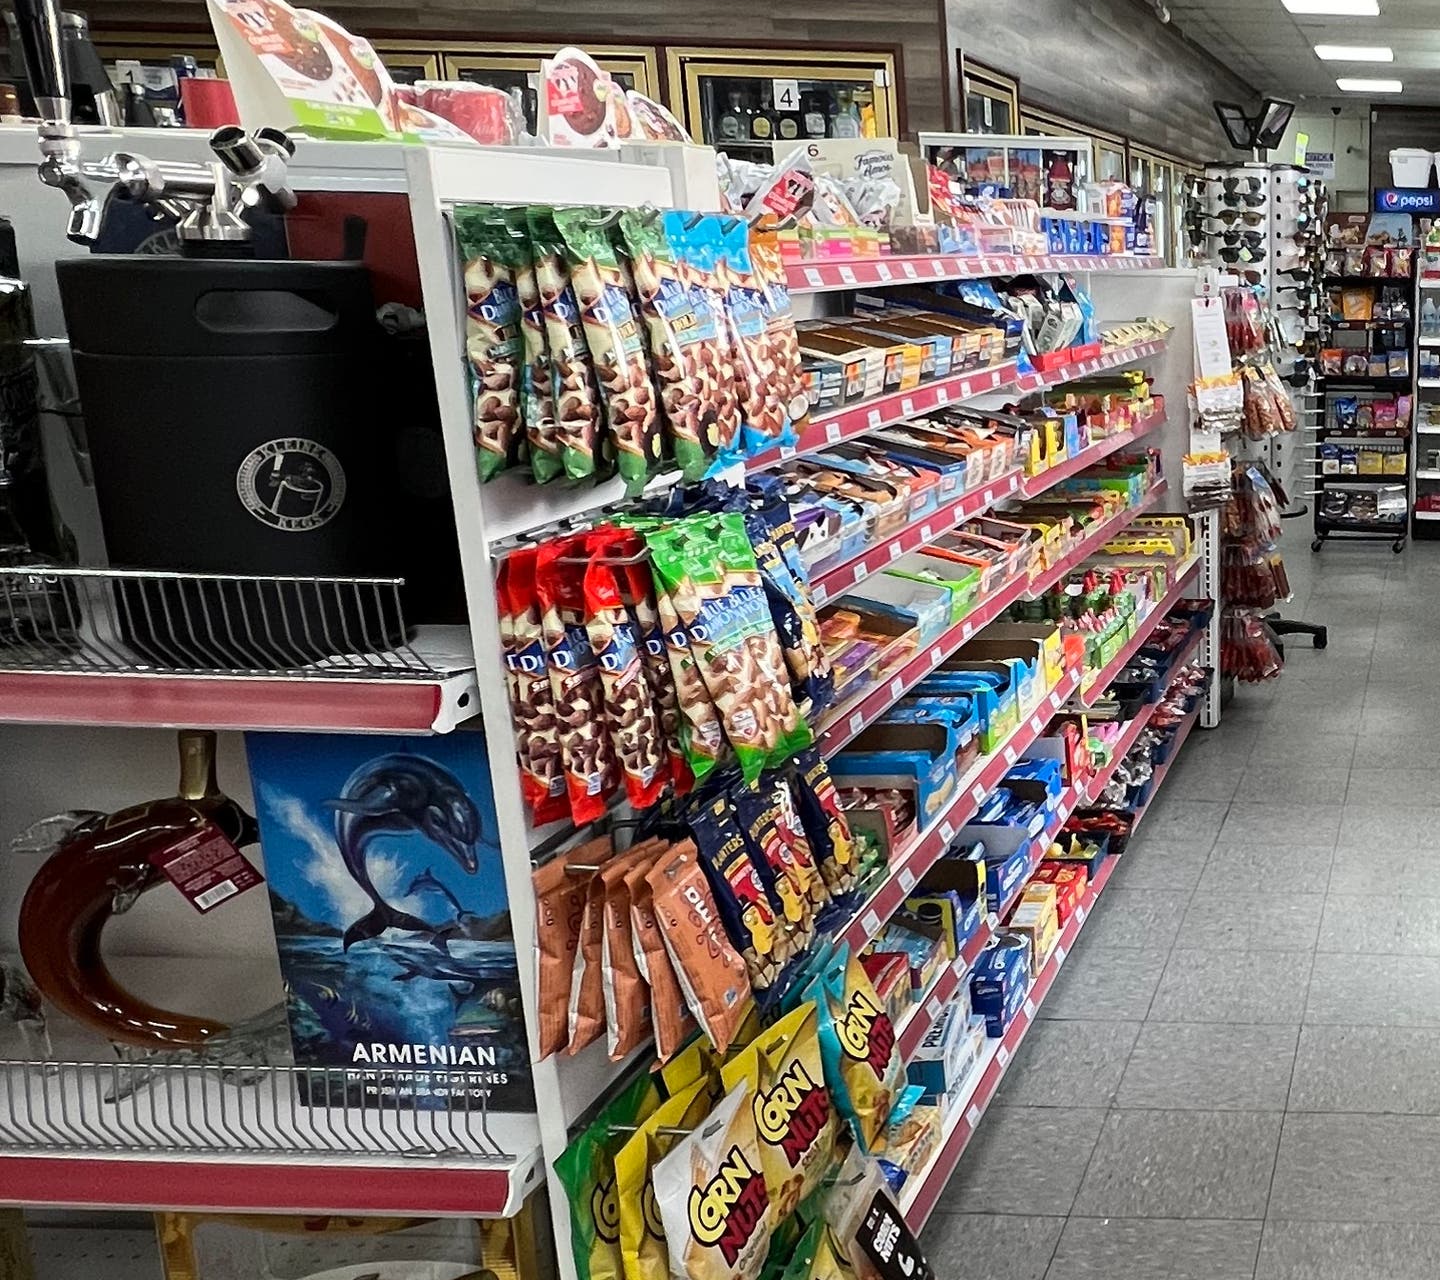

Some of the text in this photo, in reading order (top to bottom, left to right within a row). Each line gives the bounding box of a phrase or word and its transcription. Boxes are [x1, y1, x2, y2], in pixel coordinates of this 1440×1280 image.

[779, 86, 794, 108] 4
[1400, 194, 1434, 209] pepsi
[352, 1042, 496, 1067] ARMENIAN
[834, 989, 880, 1063] CORN
[751, 1058, 816, 1147] CORN
[779, 1083, 830, 1169] NUTS
[687, 1144, 754, 1248] CORN
